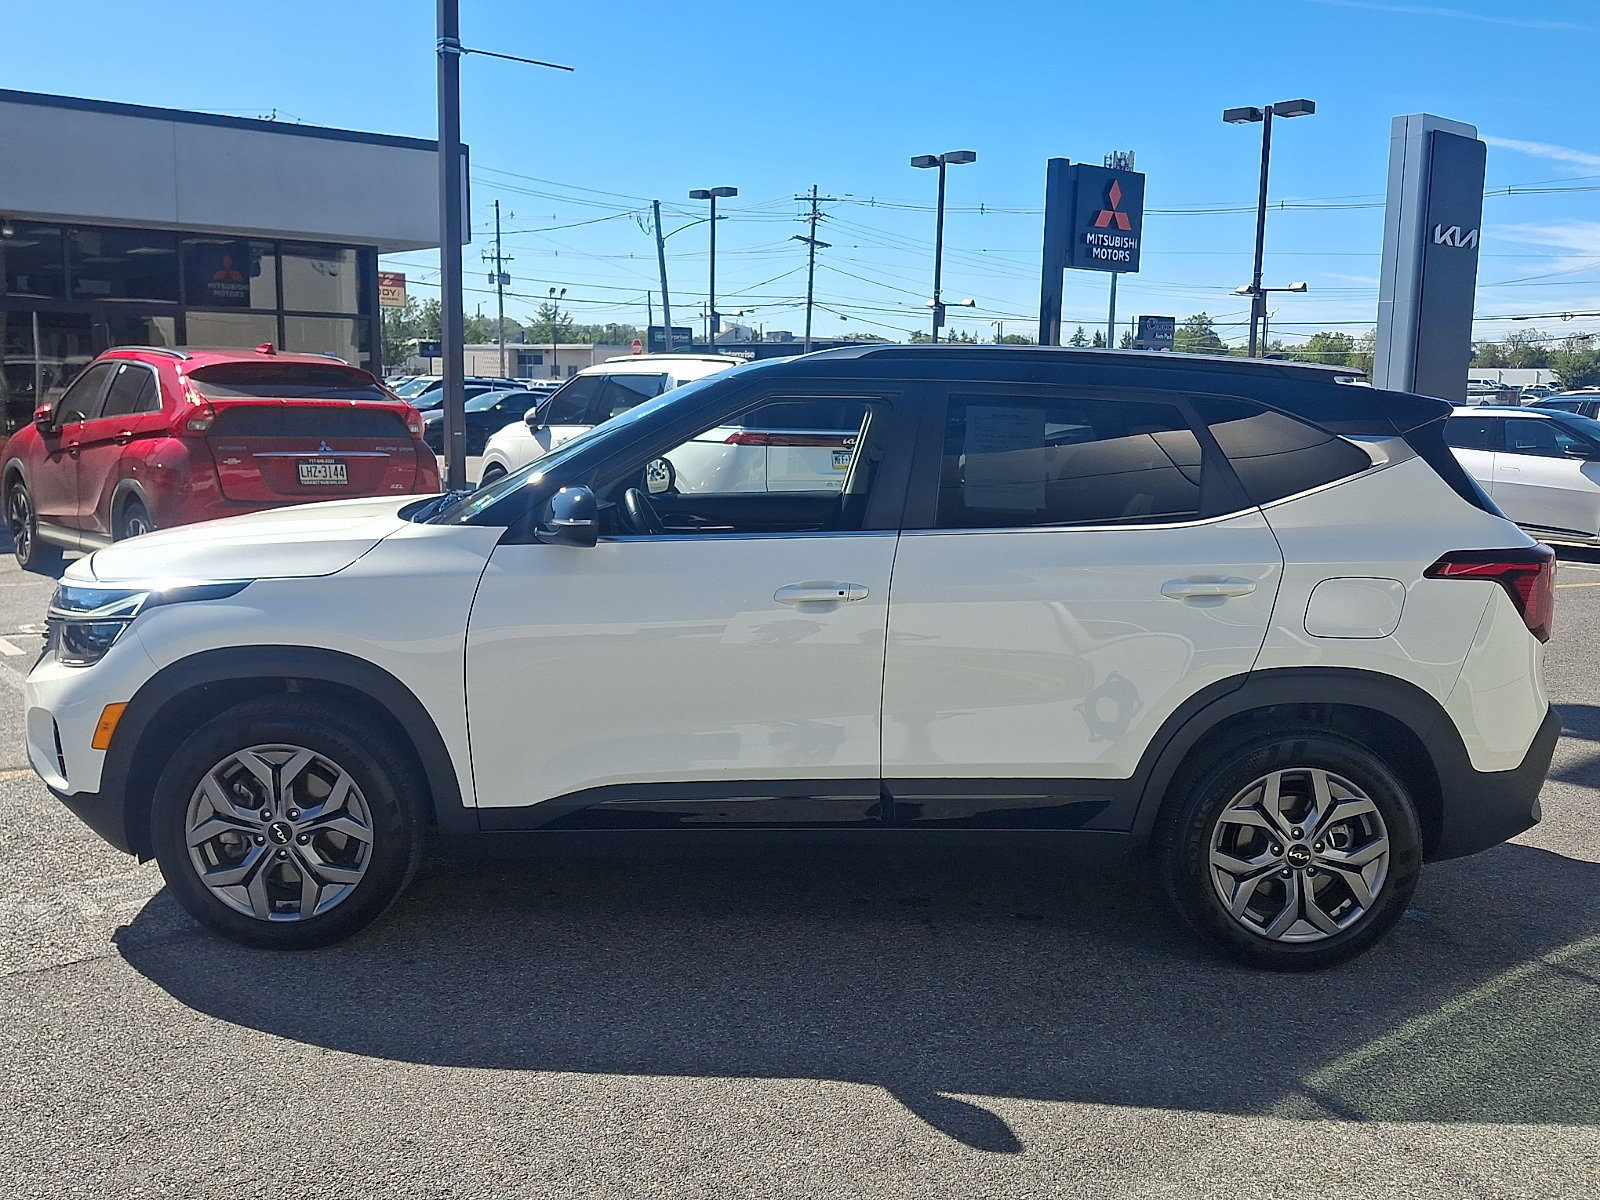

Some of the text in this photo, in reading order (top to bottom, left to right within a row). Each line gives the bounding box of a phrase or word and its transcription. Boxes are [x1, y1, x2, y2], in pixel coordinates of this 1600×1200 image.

[1086, 232, 1138, 249] MITSUBISHI
[1434, 223, 1478, 250] KIA
[1092, 247, 1130, 262] MOTORS
[1288, 850, 1310, 861] KIA
